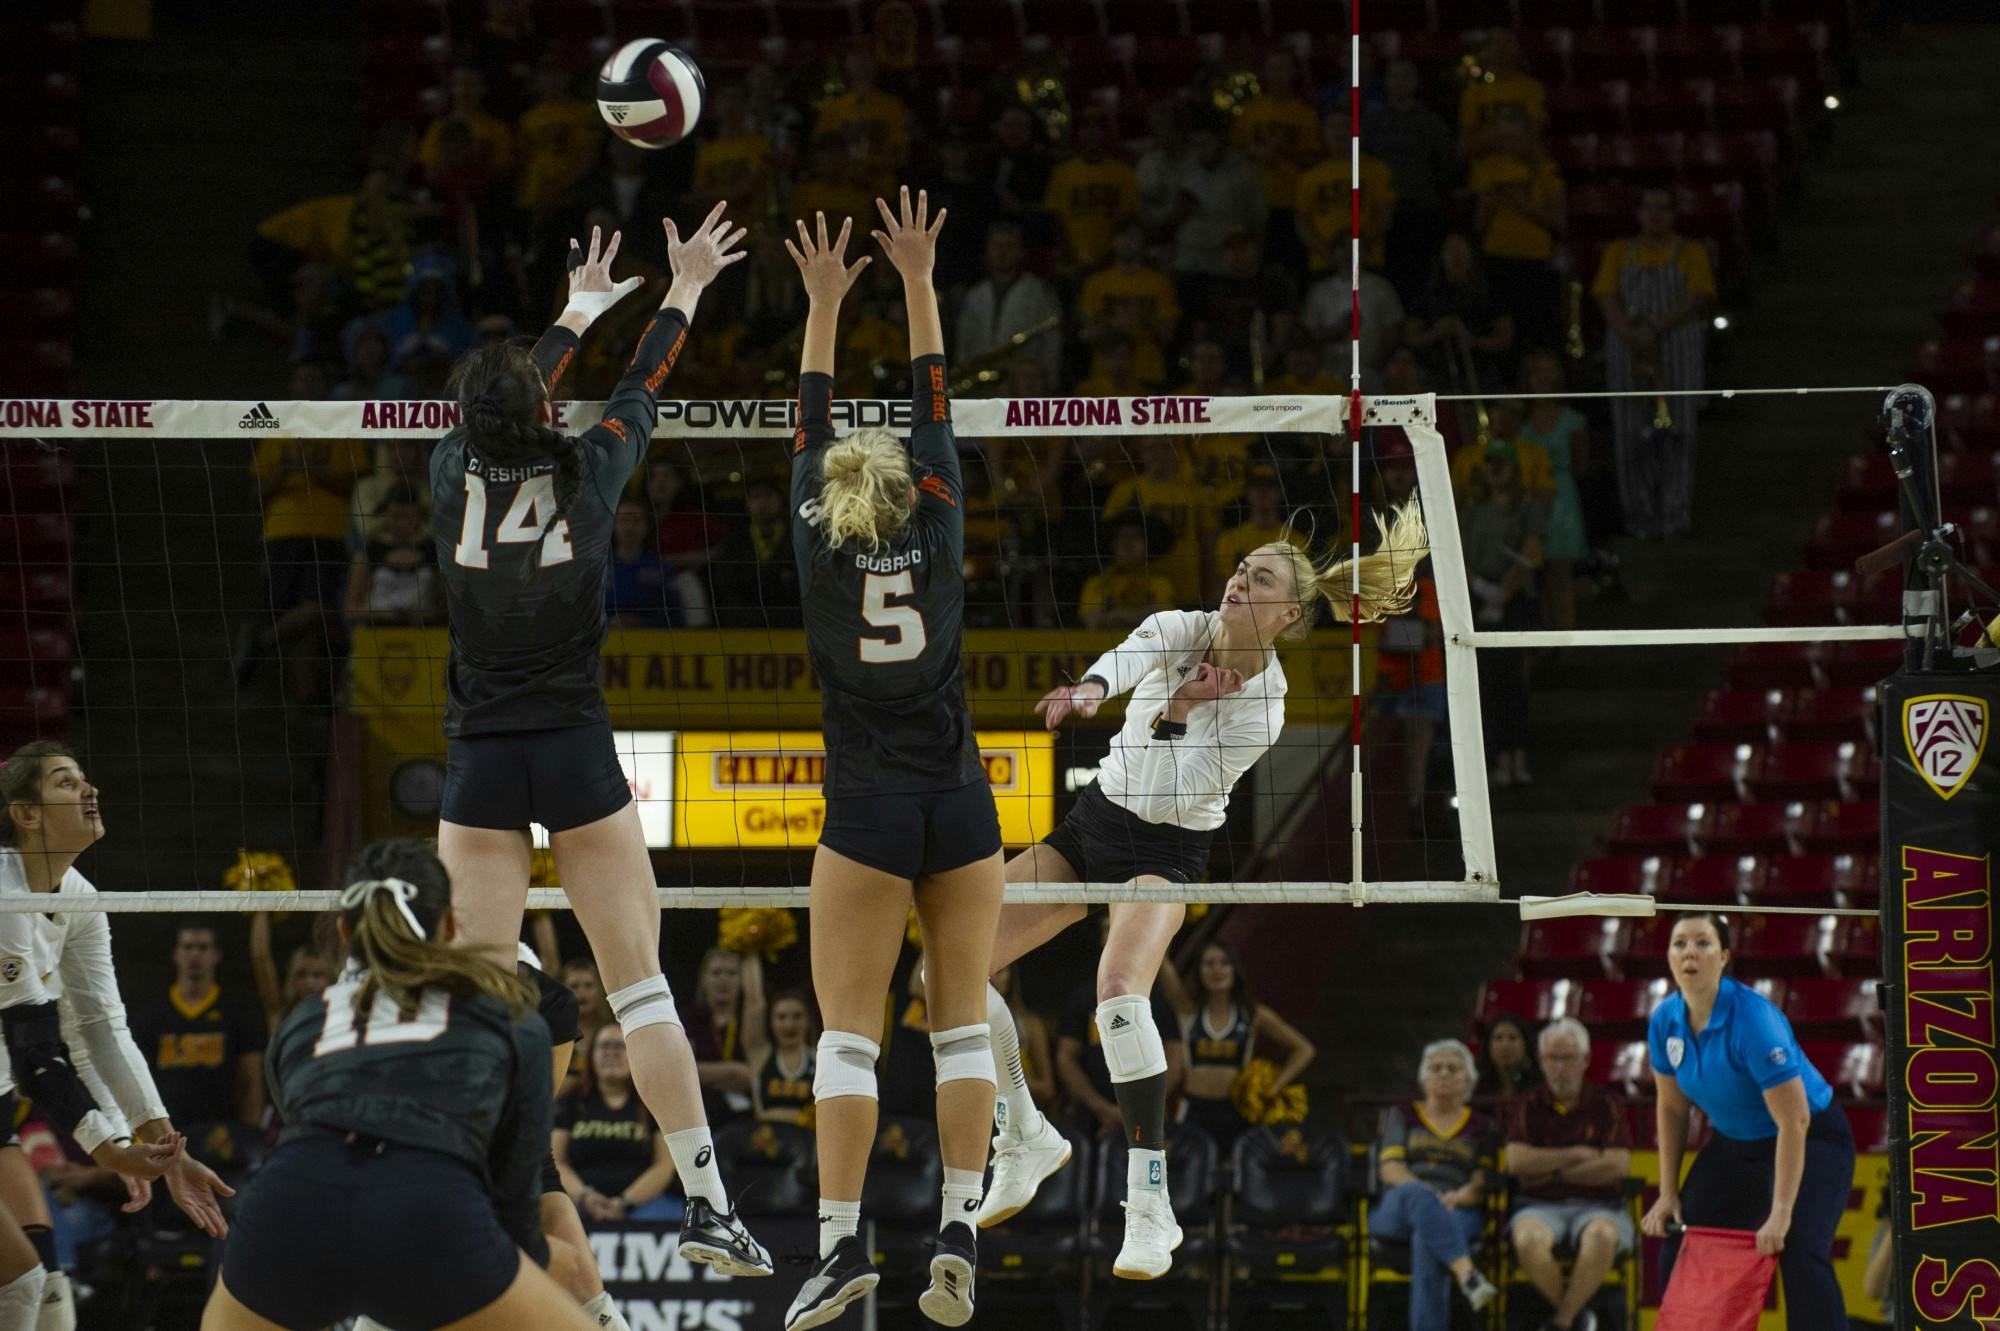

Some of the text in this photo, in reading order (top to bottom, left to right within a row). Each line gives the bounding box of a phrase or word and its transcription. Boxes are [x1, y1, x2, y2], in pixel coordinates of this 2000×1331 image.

[0, 401, 153, 428] ONA STATE
[361, 402, 463, 429] ARIZON
[654, 401, 912, 428] POWEADE
[1006, 398, 1211, 427] ARIZONA STATE
[1253, 403, 1302, 412] sports imports
[238, 417, 280, 429] adidas
[467, 458, 554, 483] CESHI
[454, 469, 575, 570] 14
[858, 566, 928, 664] 5
[645, 654, 712, 689] ALL
[728, 654, 821, 690] HOP
[1909, 700, 1984, 758] PAC
[1932, 749, 1962, 776] 12
[1902, 845, 2000, 1231] ARIZONA
